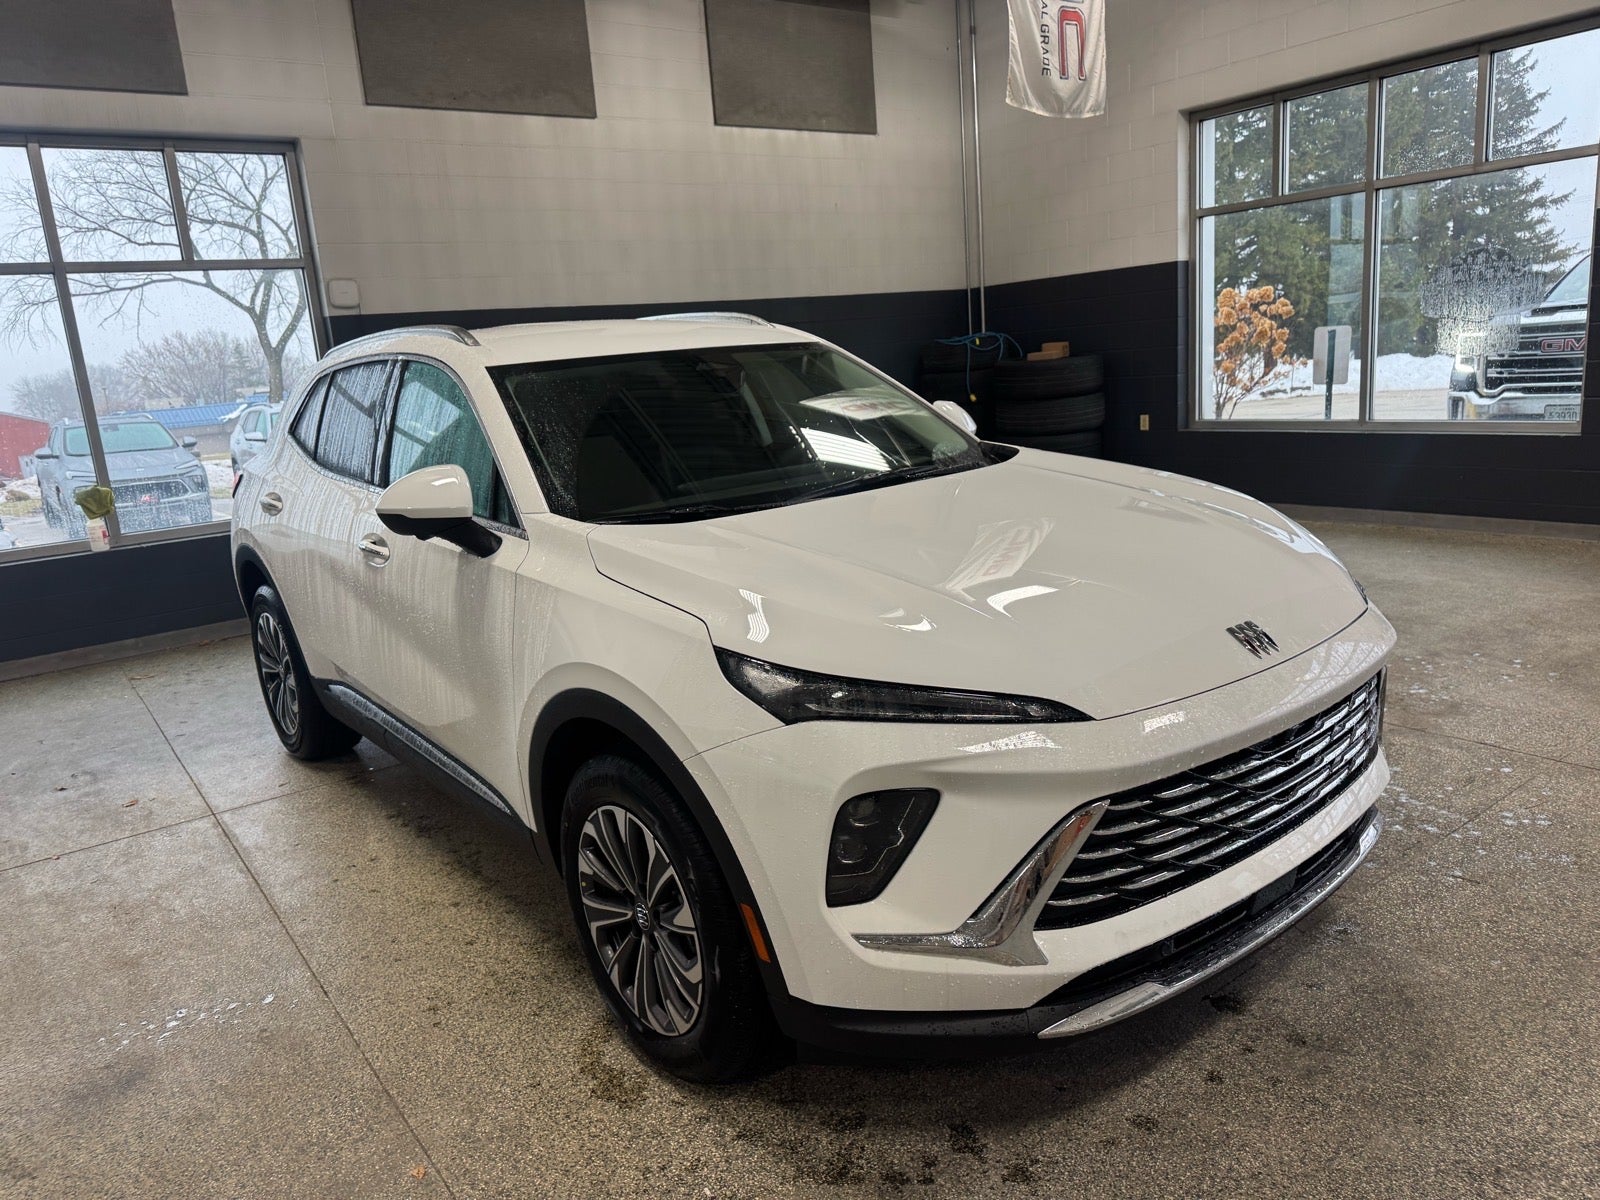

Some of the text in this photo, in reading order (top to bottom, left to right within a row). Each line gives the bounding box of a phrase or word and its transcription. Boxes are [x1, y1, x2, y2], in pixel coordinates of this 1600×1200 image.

[1040, 23, 1051, 77] GRADE
[1058, 0, 1086, 80] C
[1541, 338, 1586, 353] GM
